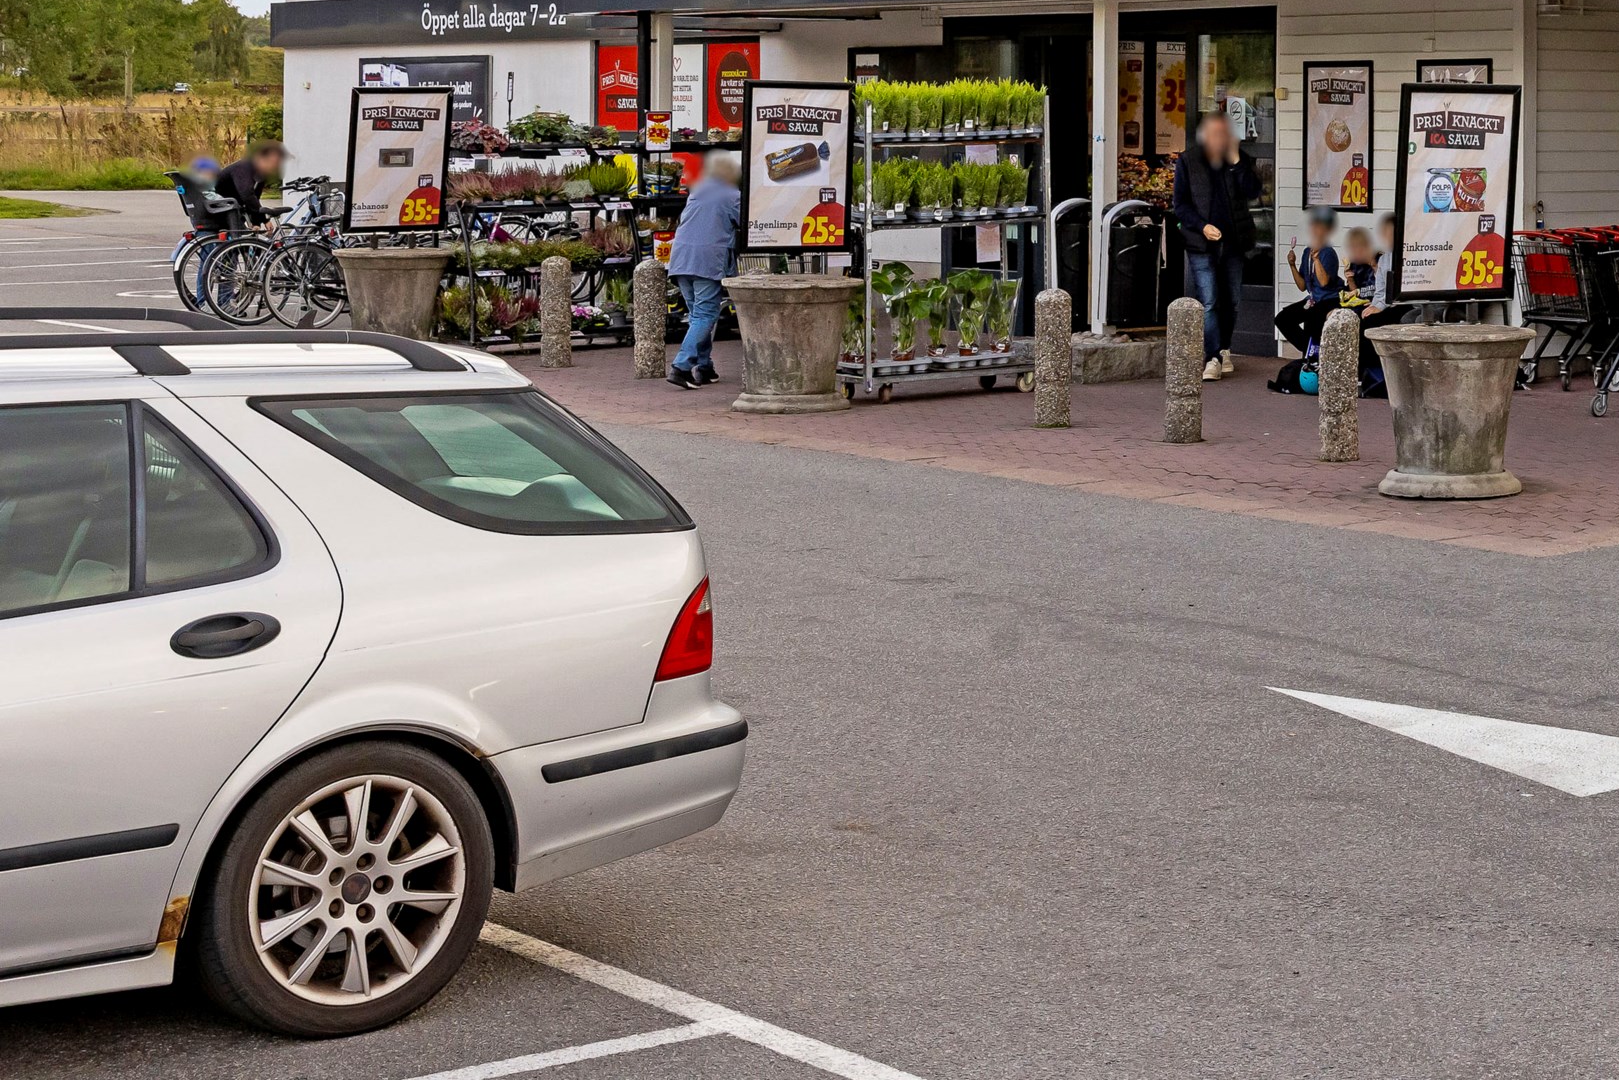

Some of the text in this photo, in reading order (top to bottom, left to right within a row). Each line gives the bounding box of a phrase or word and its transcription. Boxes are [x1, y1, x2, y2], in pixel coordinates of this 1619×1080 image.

[421, 3, 459, 36] Öppet
[463, 4, 486, 29] alla
[489, 3, 527, 33] dagar
[1312, 80, 1328, 91] PRIS
[364, 108, 437, 119] PRIS KNÄCKT
[758, 107, 838, 121] PRIS KNÄCKT
[376, 120, 420, 129] ICA SÄVJA
[771, 122, 819, 133] ICA SÄVJA
[1416, 114, 1500, 131] PRIS KNÄCKT
[1429, 133, 1480, 146] ICA SÄVJA
[351, 202, 389, 210] Kabanoss
[401, 198, 440, 222] 35:-
[748, 220, 798, 231] Pågenlimpa
[802, 215, 845, 244] 25:-
[1458, 250, 1504, 285] 35:-
